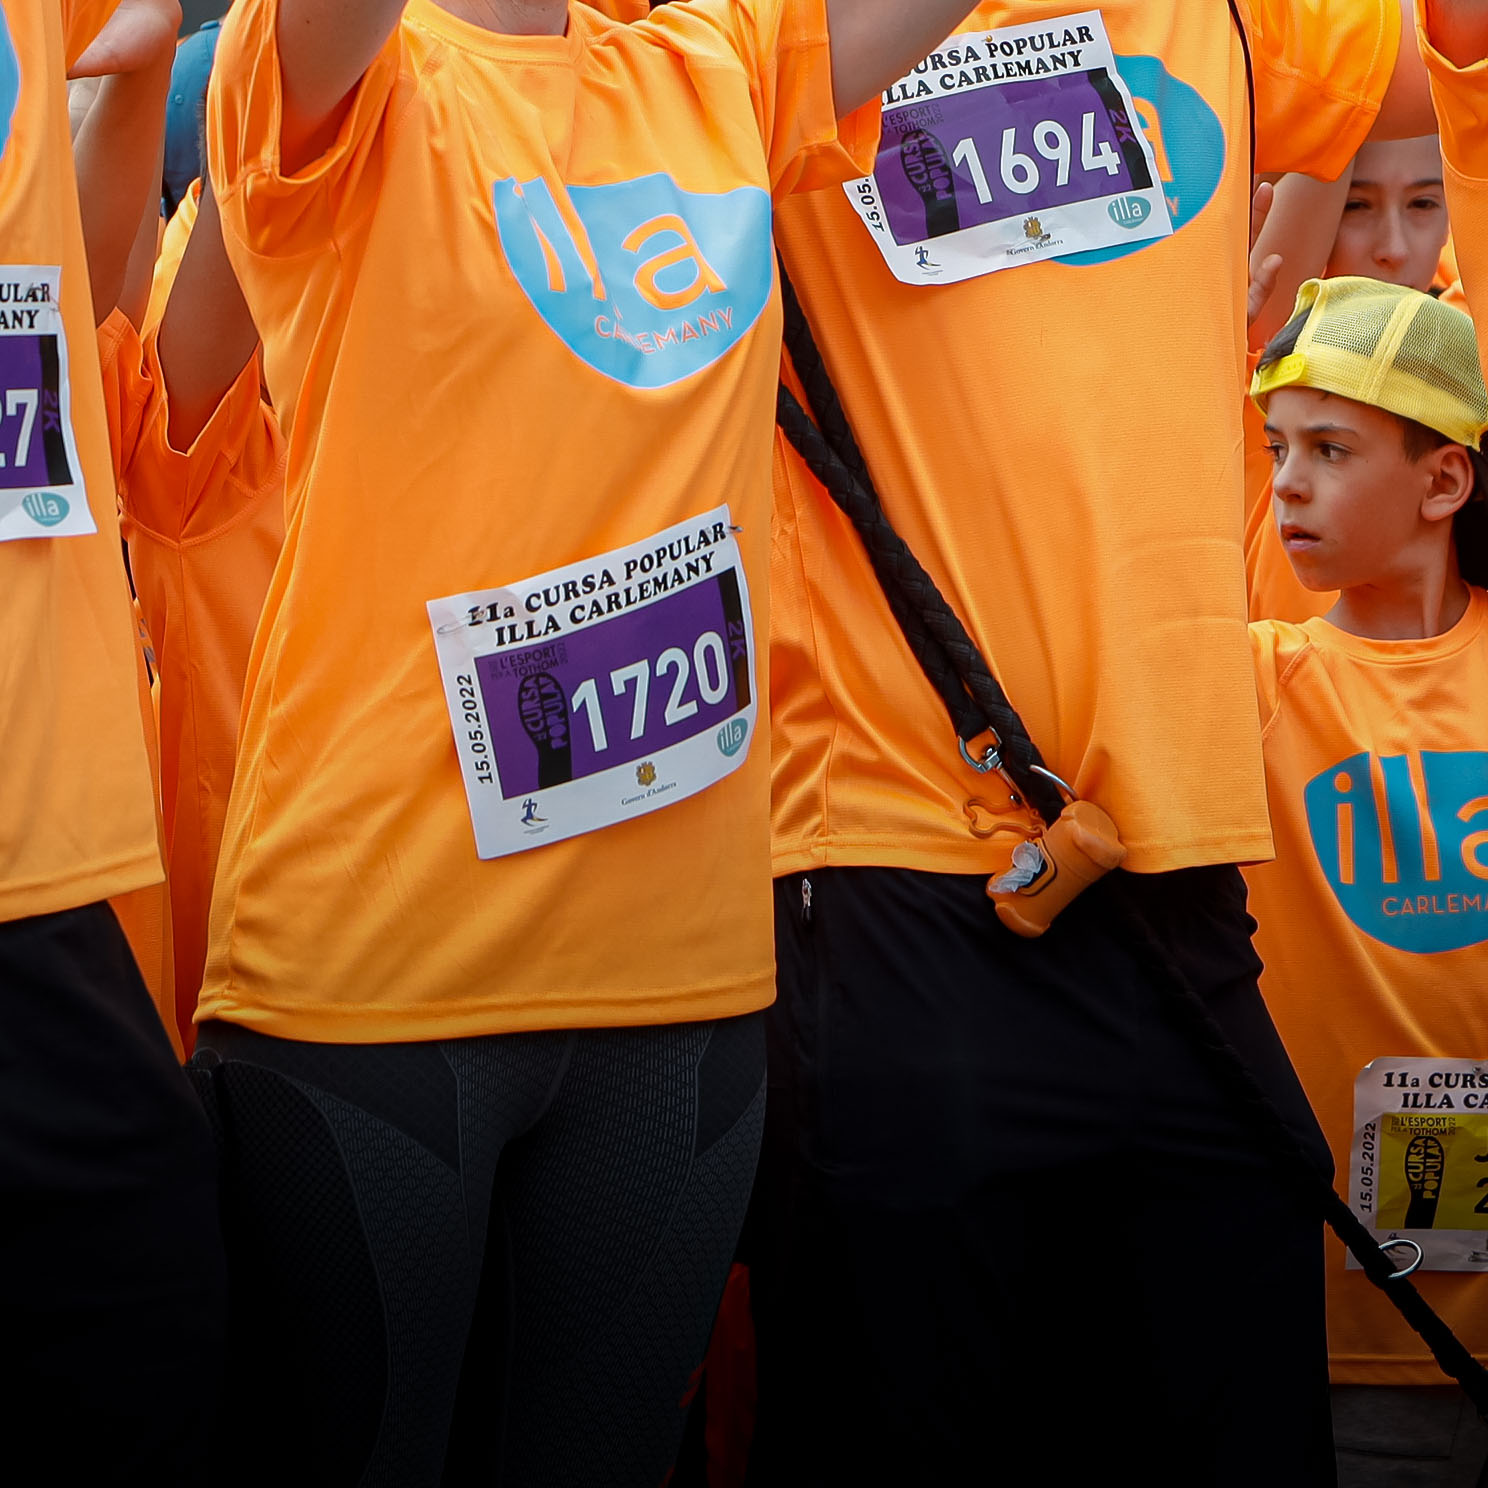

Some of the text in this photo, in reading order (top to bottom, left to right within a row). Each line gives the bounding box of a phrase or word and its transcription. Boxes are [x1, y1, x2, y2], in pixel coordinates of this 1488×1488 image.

[900, 24, 1095, 79] URSA POPULAR
[883, 48, 1084, 106] LLA CARLEMANY
[1111, 109, 1137, 145] 2K
[952, 111, 1122, 206] 1694
[858, 177, 885, 234] 15.05.
[1112, 196, 1143, 221] illa
[513, 176, 728, 311] ila
[594, 307, 735, 355] CAEMANY
[27, 493, 59, 517] illa
[468, 521, 727, 627] 11a CURSA POPULAR
[496, 551, 715, 646] ILLA CARLEMANY
[727, 619, 747, 661] 2K
[571, 631, 729, 753] 1720
[457, 674, 493, 785] 15.05.2022
[720, 721, 742, 750] illa
[621, 794, 646, 806] Govern
[1383, 1072, 1420, 1088] 11a
[1401, 1092, 1455, 1109] ILLA
[1401, 1117, 1447, 1127] L'ESPORT
[1410, 1127, 1448, 1136] TOTHOM
[1360, 1122, 1377, 1213] 15.05.2022
[1407, 1138, 1425, 1182] CURSA
